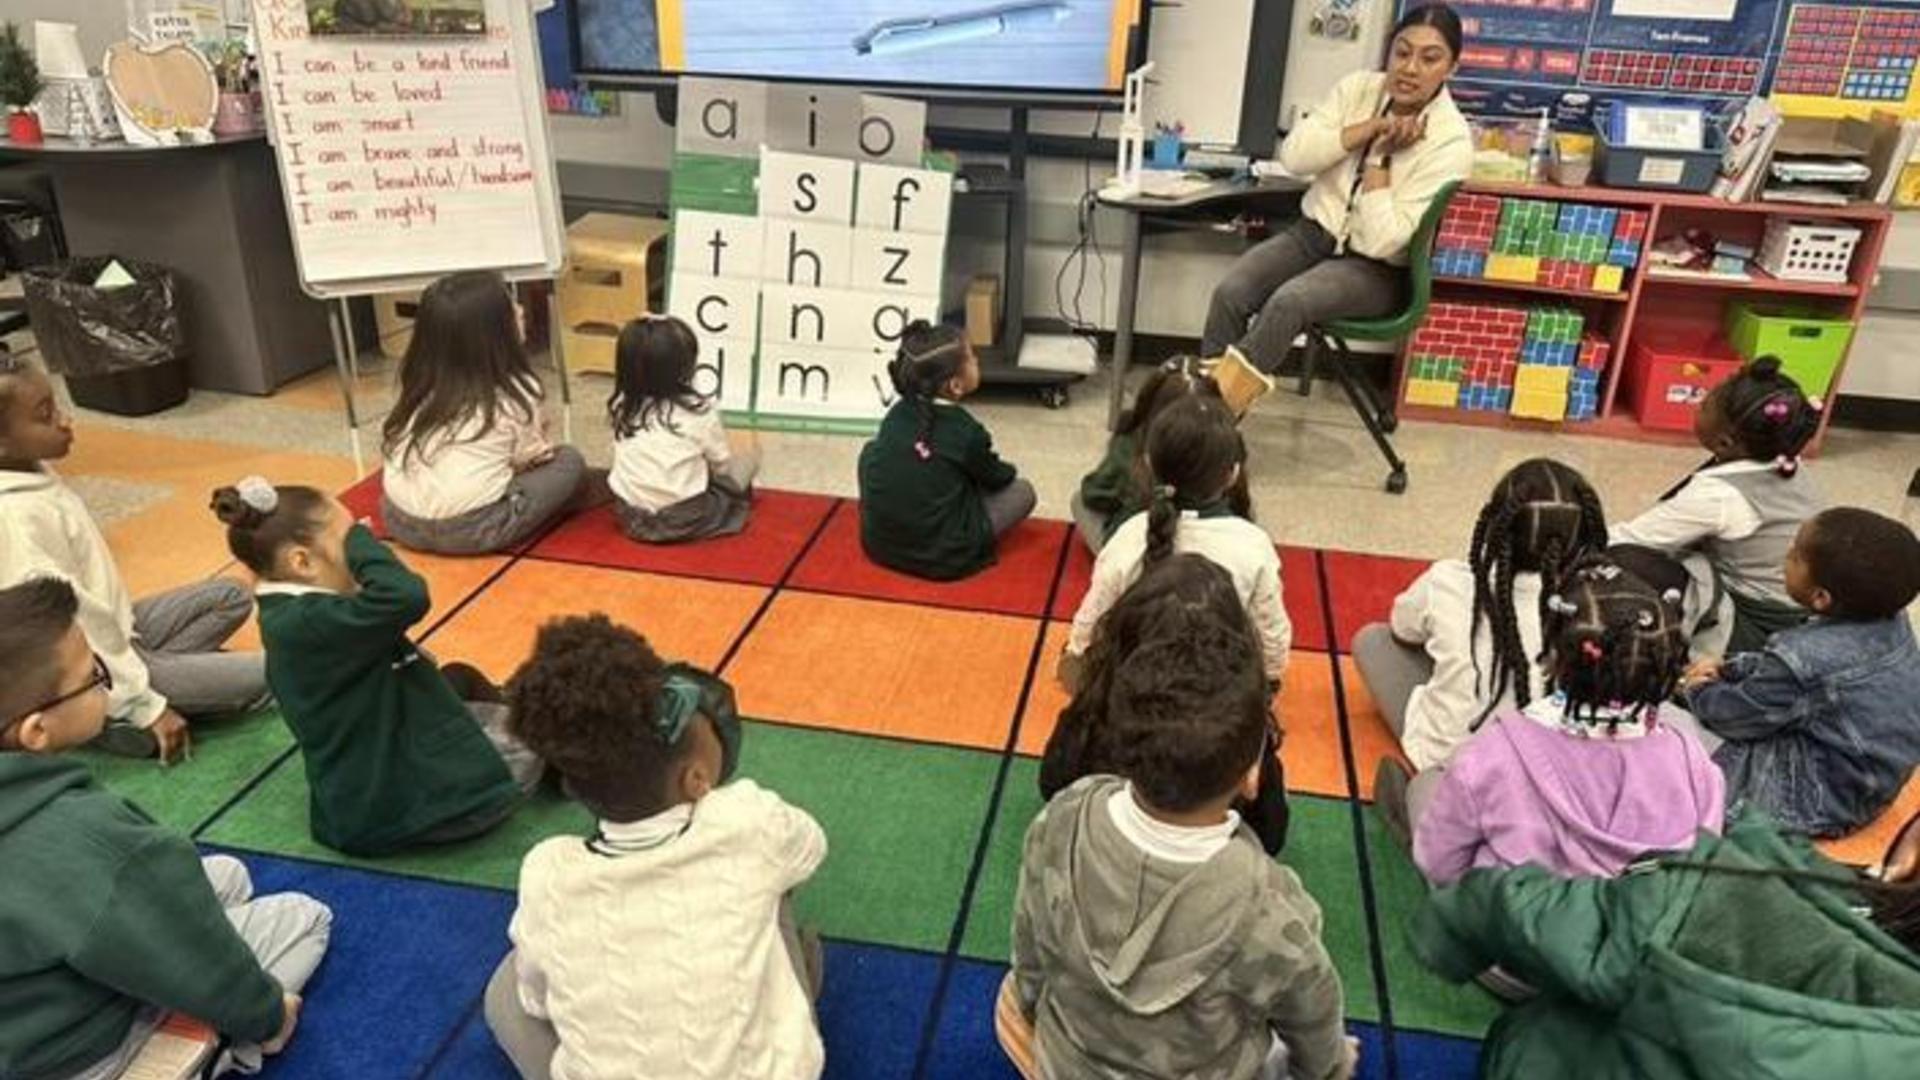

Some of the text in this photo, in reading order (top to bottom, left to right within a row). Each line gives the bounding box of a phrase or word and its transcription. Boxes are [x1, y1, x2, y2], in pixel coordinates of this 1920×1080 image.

[273, 48, 510, 75] I can be a kind friend
[273, 80, 442, 105] I can be loved
[282, 108, 414, 135] I am smart
[702, 98, 737, 140] a
[808, 95, 818, 148] i
[859, 116, 895, 157] o
[286, 134, 524, 166] I am brave and strong
[296, 172, 308, 195] I
[326, 180, 353, 193] am
[793, 172, 818, 213] s
[298, 195, 437, 228] I am mighty
[891, 177, 921, 232] f
[707, 229, 728, 277] t
[787, 230, 821, 288] h
[882, 247, 910, 285] z
[695, 295, 729, 333] c
[790, 303, 824, 341] n
[778, 361, 830, 401] m
